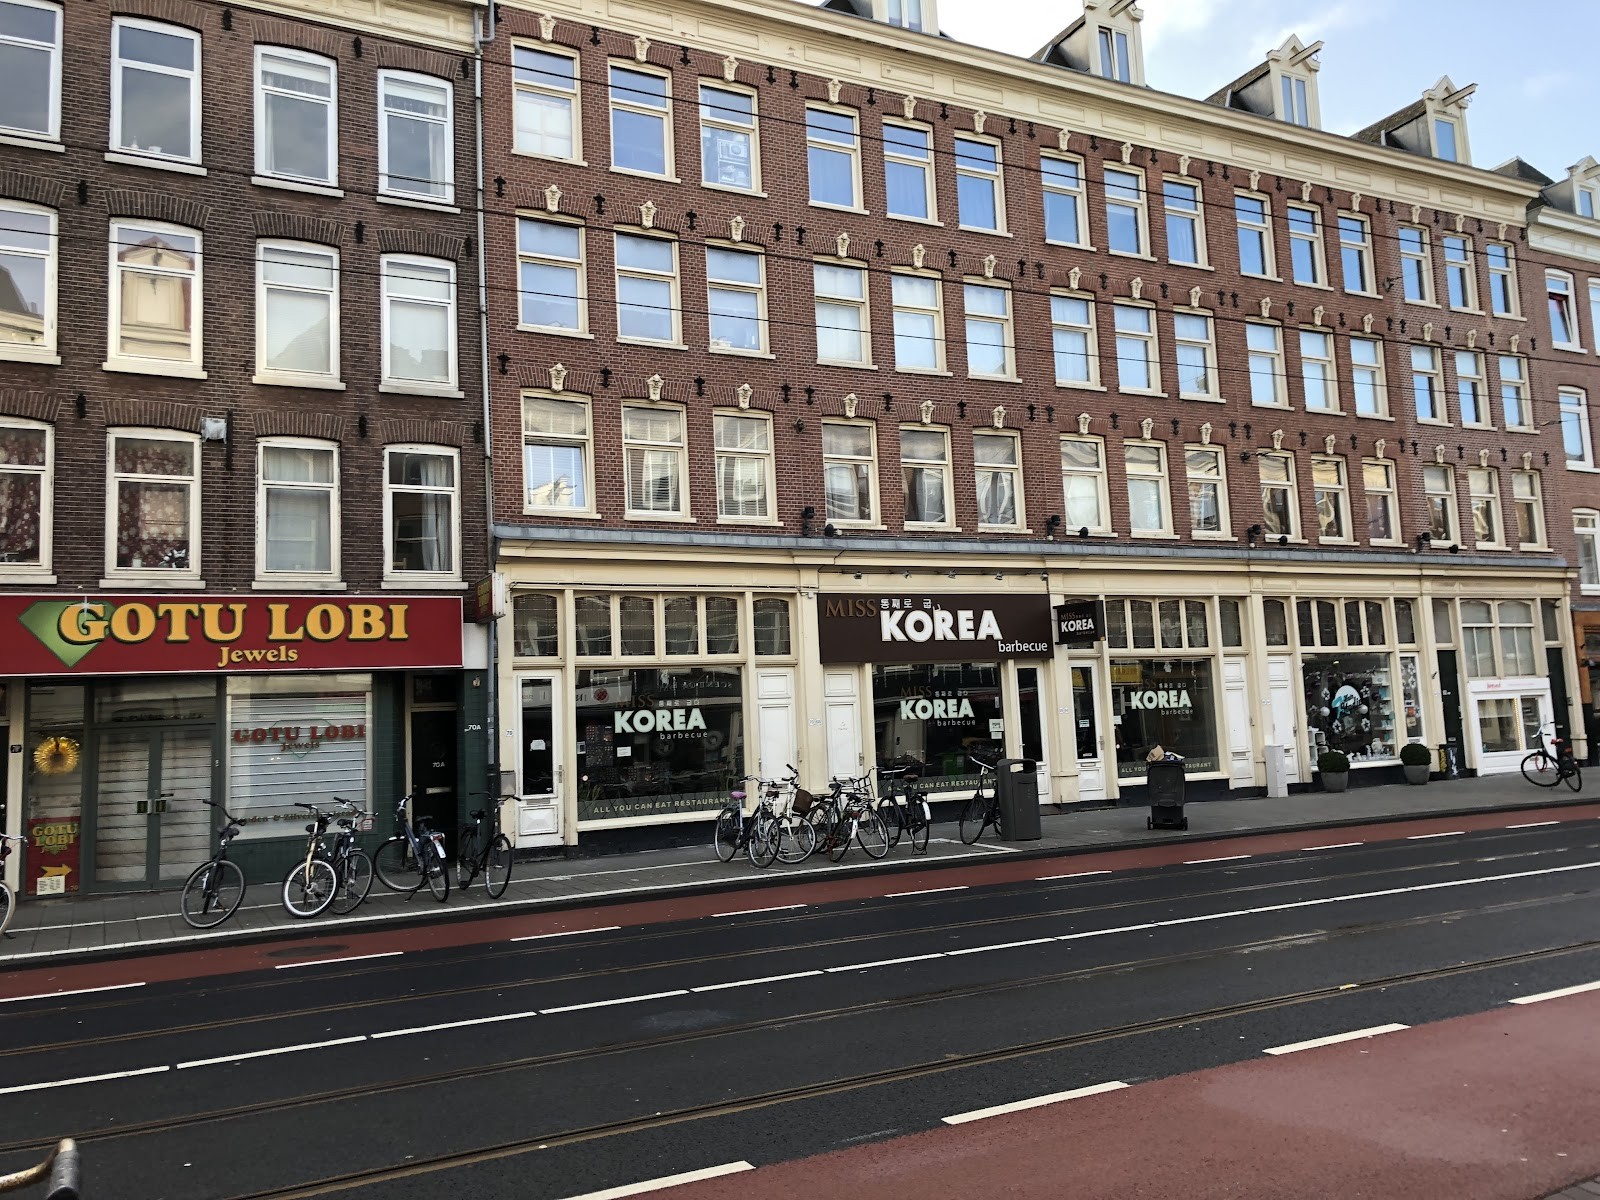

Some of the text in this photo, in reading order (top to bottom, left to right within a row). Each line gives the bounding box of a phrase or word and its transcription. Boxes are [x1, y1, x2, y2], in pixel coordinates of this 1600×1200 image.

[825, 599, 877, 618] MISS
[58, 602, 409, 644] GOTU LOBI
[880, 609, 1003, 643] KOREA
[1061, 618, 1094, 633] KOREA
[998, 640, 1048, 653] barbecue
[217, 645, 299, 668] Jewels
[901, 685, 932, 697] MISS
[1130, 689, 1193, 710] KOREA
[900, 698, 975, 720] KOREA
[1161, 708, 1193, 716] barbecue
[614, 708, 707, 734] KOREA
[937, 719, 976, 727] barbecue
[233, 724, 366, 743] GOTU LOBI
[659, 731, 709, 740] barbecue
[593, 806, 610, 814] ALL
[613, 804, 632, 812] YOU
[634, 802, 653, 810] CAN
[674, 797, 731, 807] RESTAURANT
[32, 823, 78, 837] GOTU
[34, 835, 75, 847] LOBI
